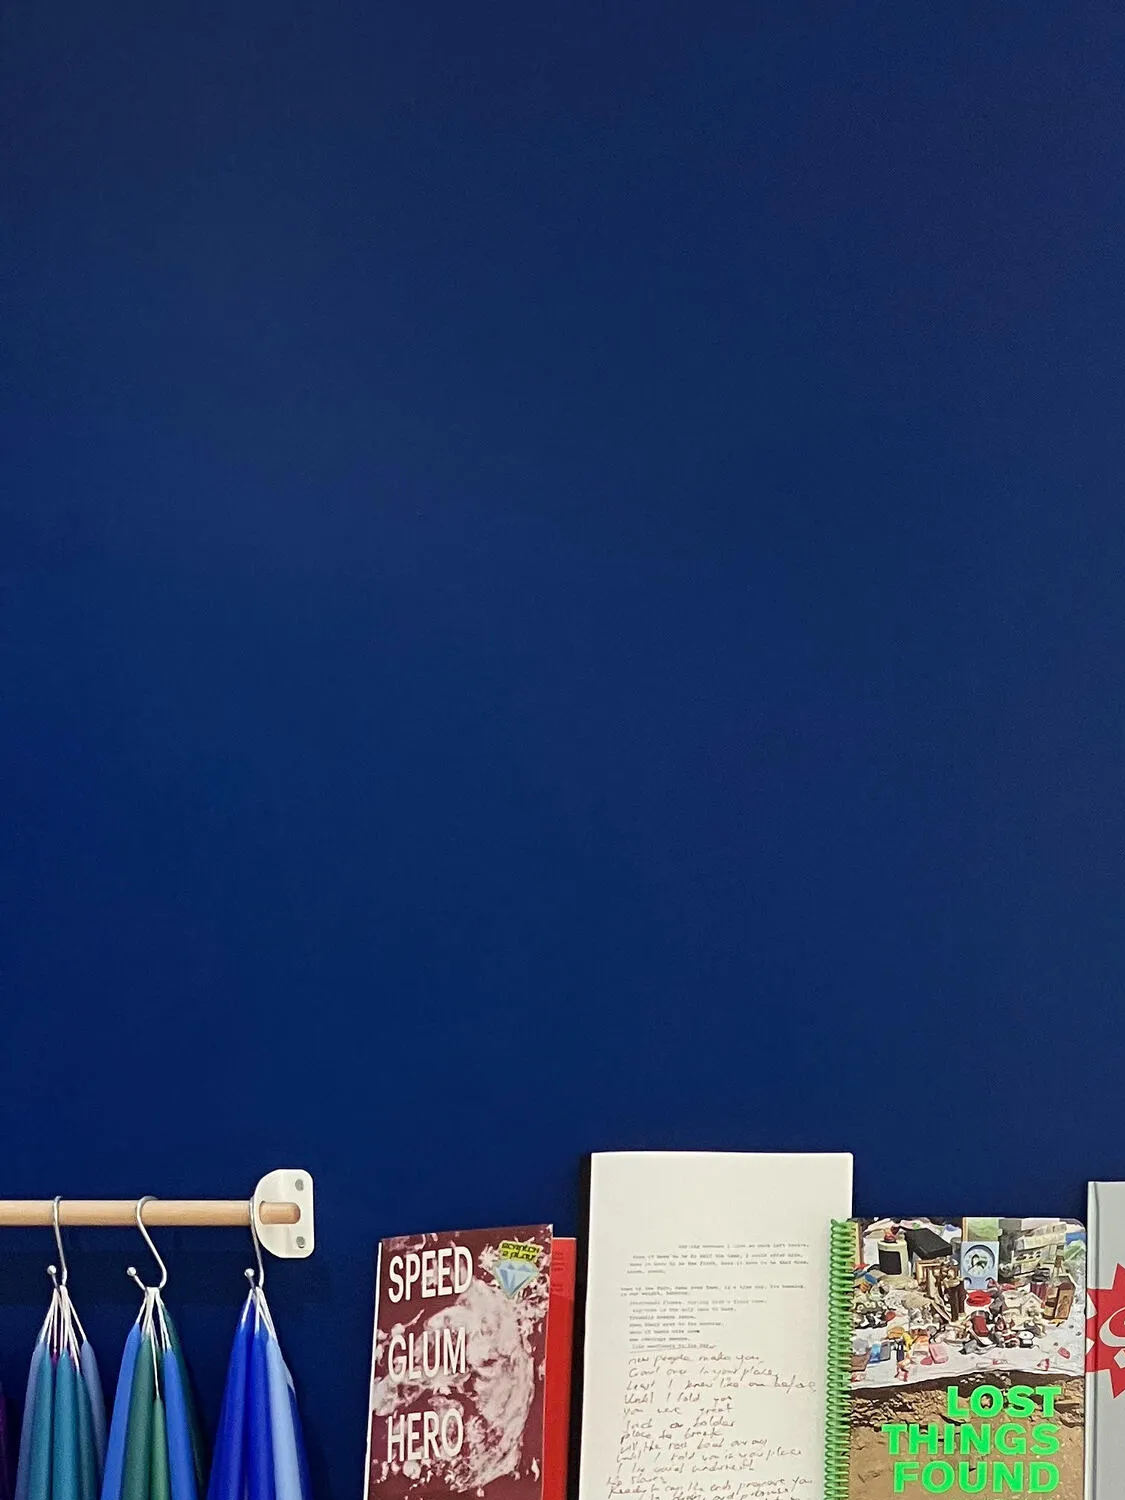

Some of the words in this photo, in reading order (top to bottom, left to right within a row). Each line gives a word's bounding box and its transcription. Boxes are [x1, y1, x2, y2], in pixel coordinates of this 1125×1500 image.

[388, 1246, 473, 1303] SPEED
[387, 1327, 467, 1379] GLUM
[947, 1384, 1062, 1420] LOST
[386, 1405, 464, 1464] HERO
[881, 1422, 1061, 1456] THINGS
[893, 1460, 1061, 1494] FOUND
